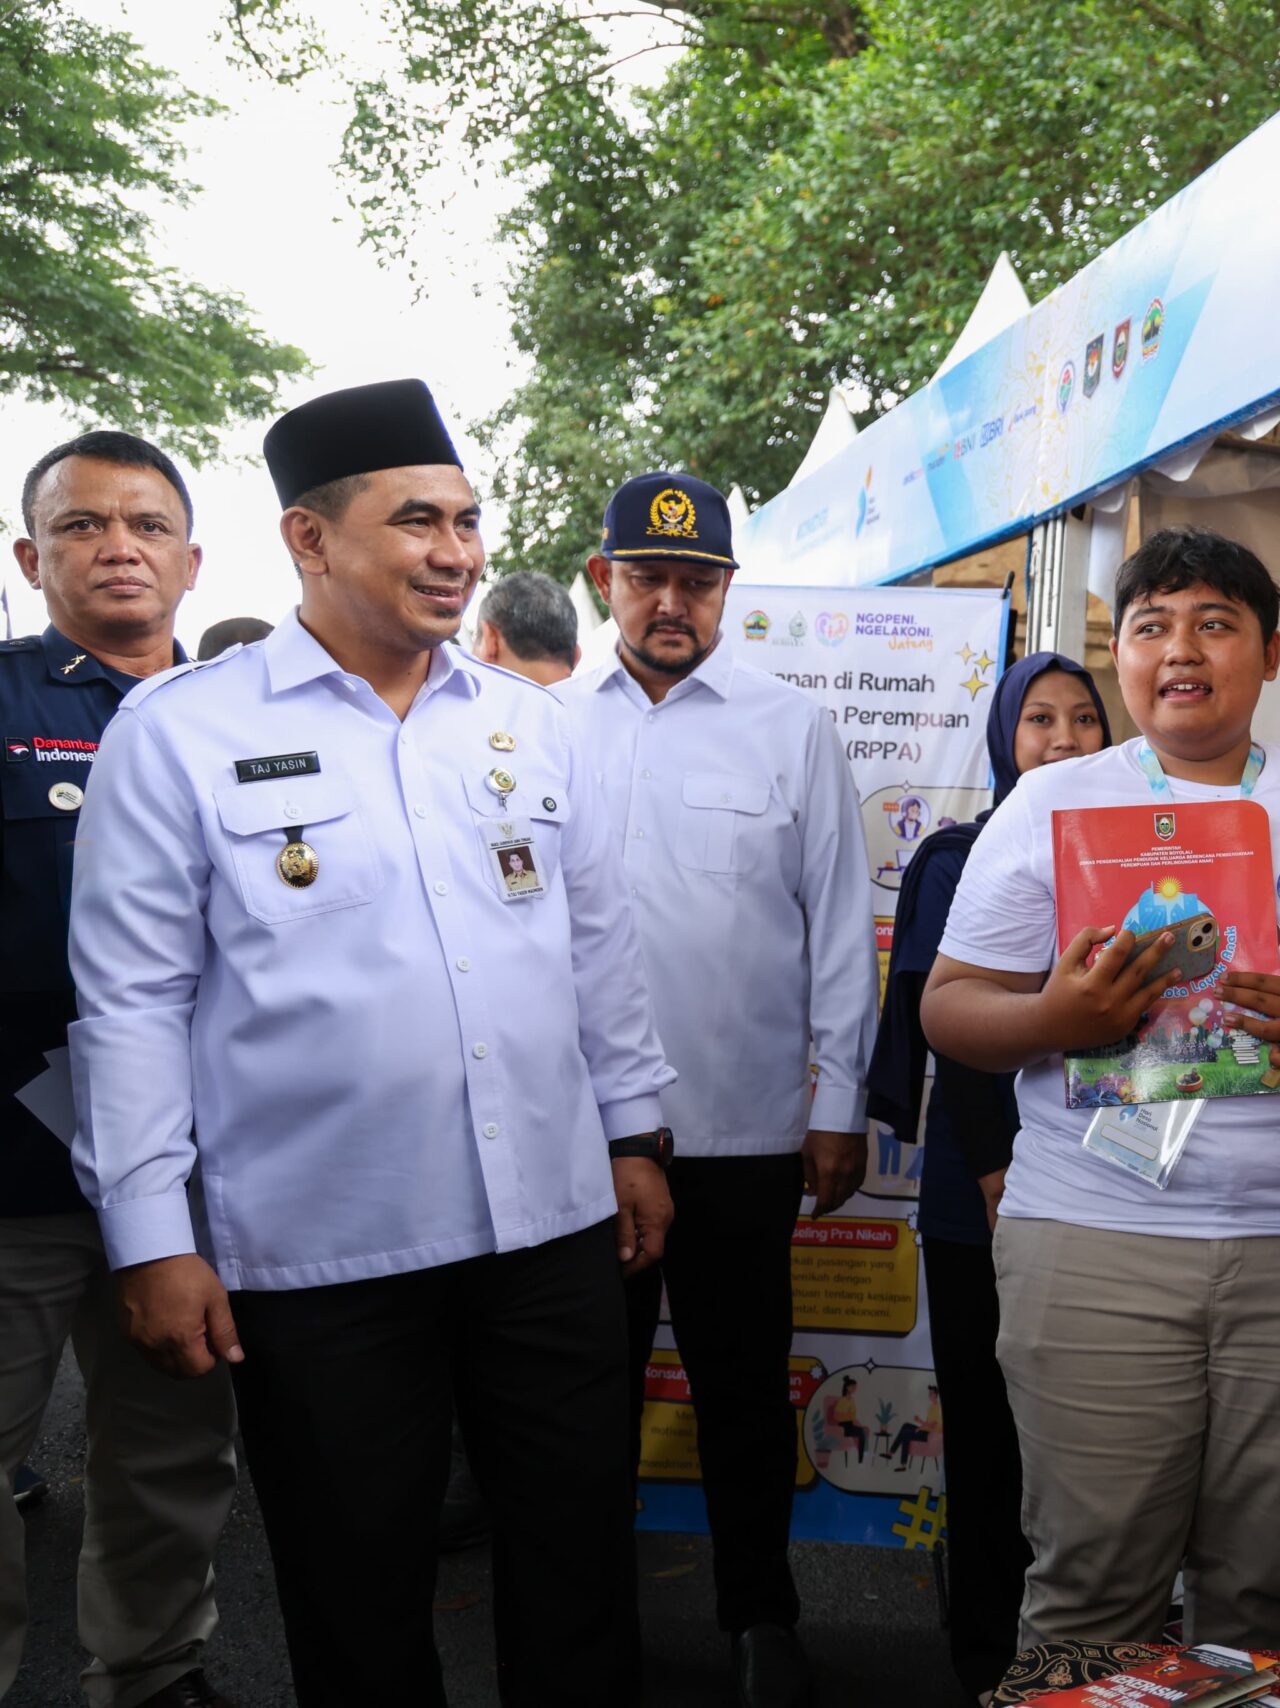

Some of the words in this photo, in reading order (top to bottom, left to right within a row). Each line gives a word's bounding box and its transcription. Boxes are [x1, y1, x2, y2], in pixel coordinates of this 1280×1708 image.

[855, 625, 934, 637] NGELAKONI.
[888, 637, 934, 652] Jateng
[834, 671, 853, 690] di
[858, 672, 935, 693] Rumah
[843, 706, 969, 732] Perempuan
[33, 737, 100, 750] Danantar
[845, 740, 922, 764] (RPPA)
[250, 763, 271, 775] TAJ
[274, 758, 306, 772] YASIN
[1161, 986, 1189, 998] ota
[1190, 964, 1227, 993] Layak
[1220, 926, 1237, 962] Anak
[1138, 1113, 1152, 1122] Desa
[1140, 1108, 1152, 1117] Hari
[1136, 1118, 1158, 1132] Nasional
[831, 1228, 854, 1240] Pra
[856, 1229, 892, 1242] Nikah
[869, 1259, 895, 1271] yang
[1105, 1673, 1188, 1701] KEKERASAN
